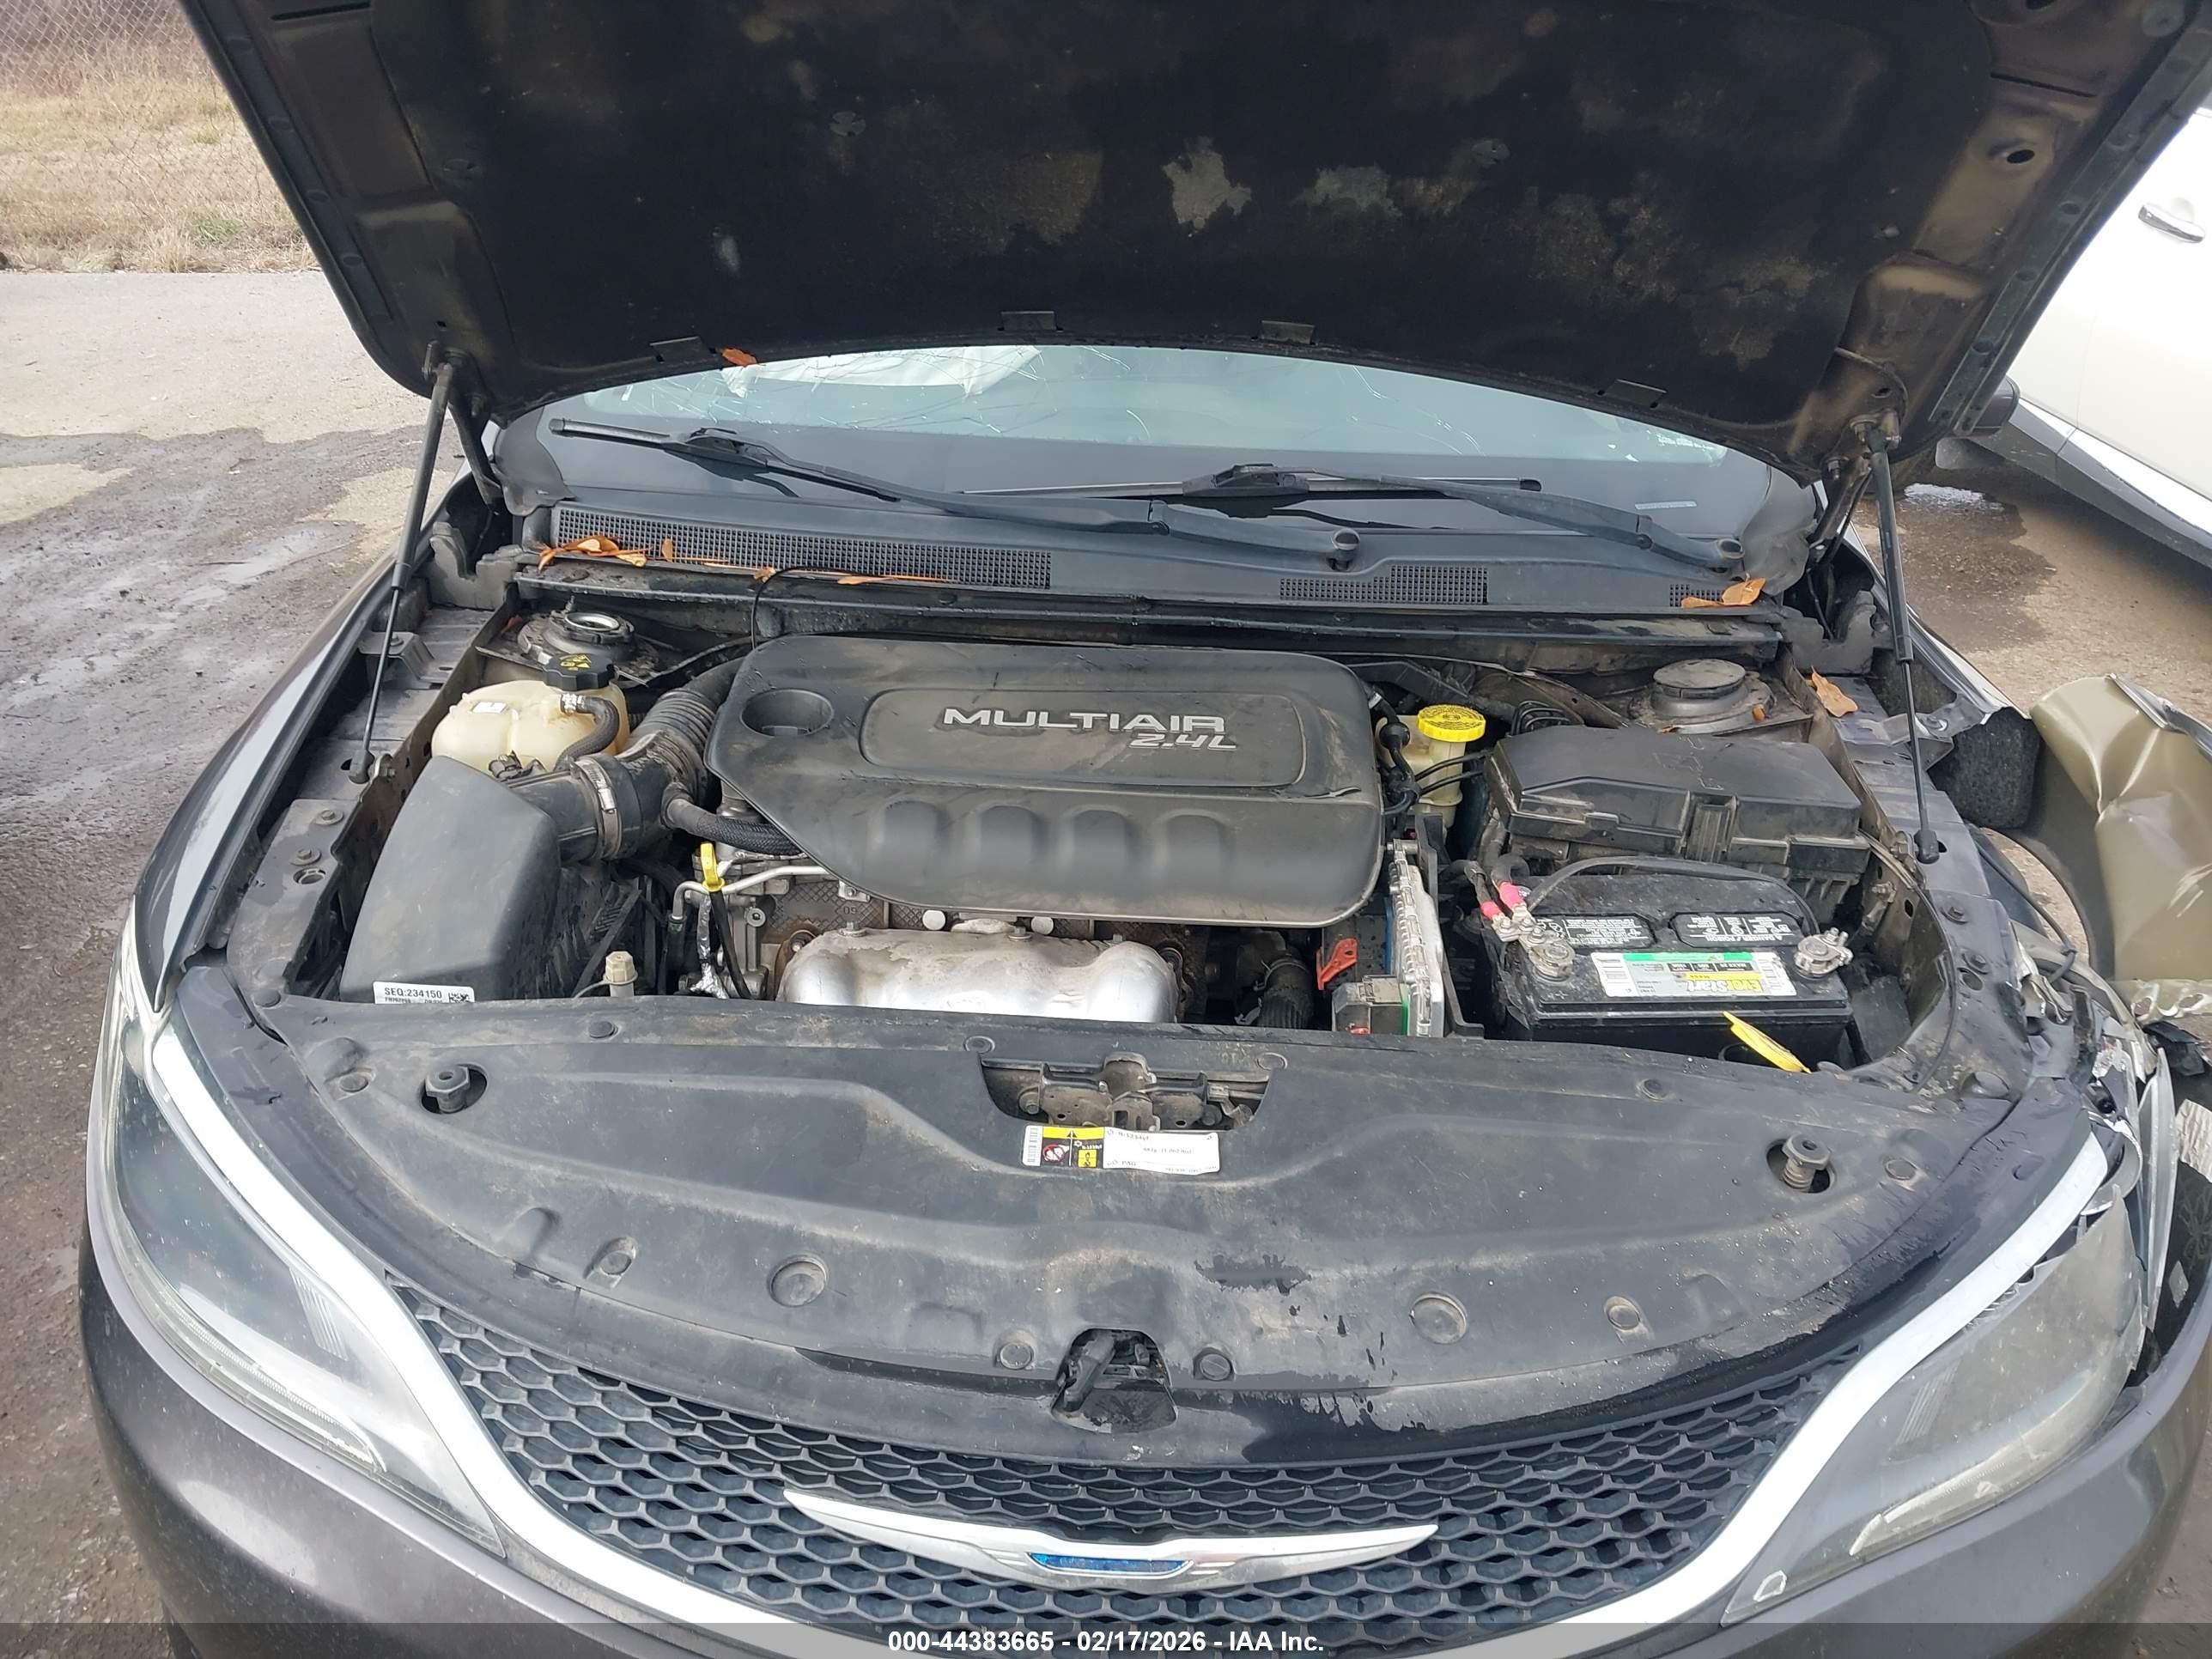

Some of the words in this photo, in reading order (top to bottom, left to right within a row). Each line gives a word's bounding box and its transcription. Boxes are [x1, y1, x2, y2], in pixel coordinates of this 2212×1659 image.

[943, 708, 1226, 732] MULTIAIR
[1128, 733, 1237, 751] 2.4L
[385, 988, 442, 1000] SEQ:234150
